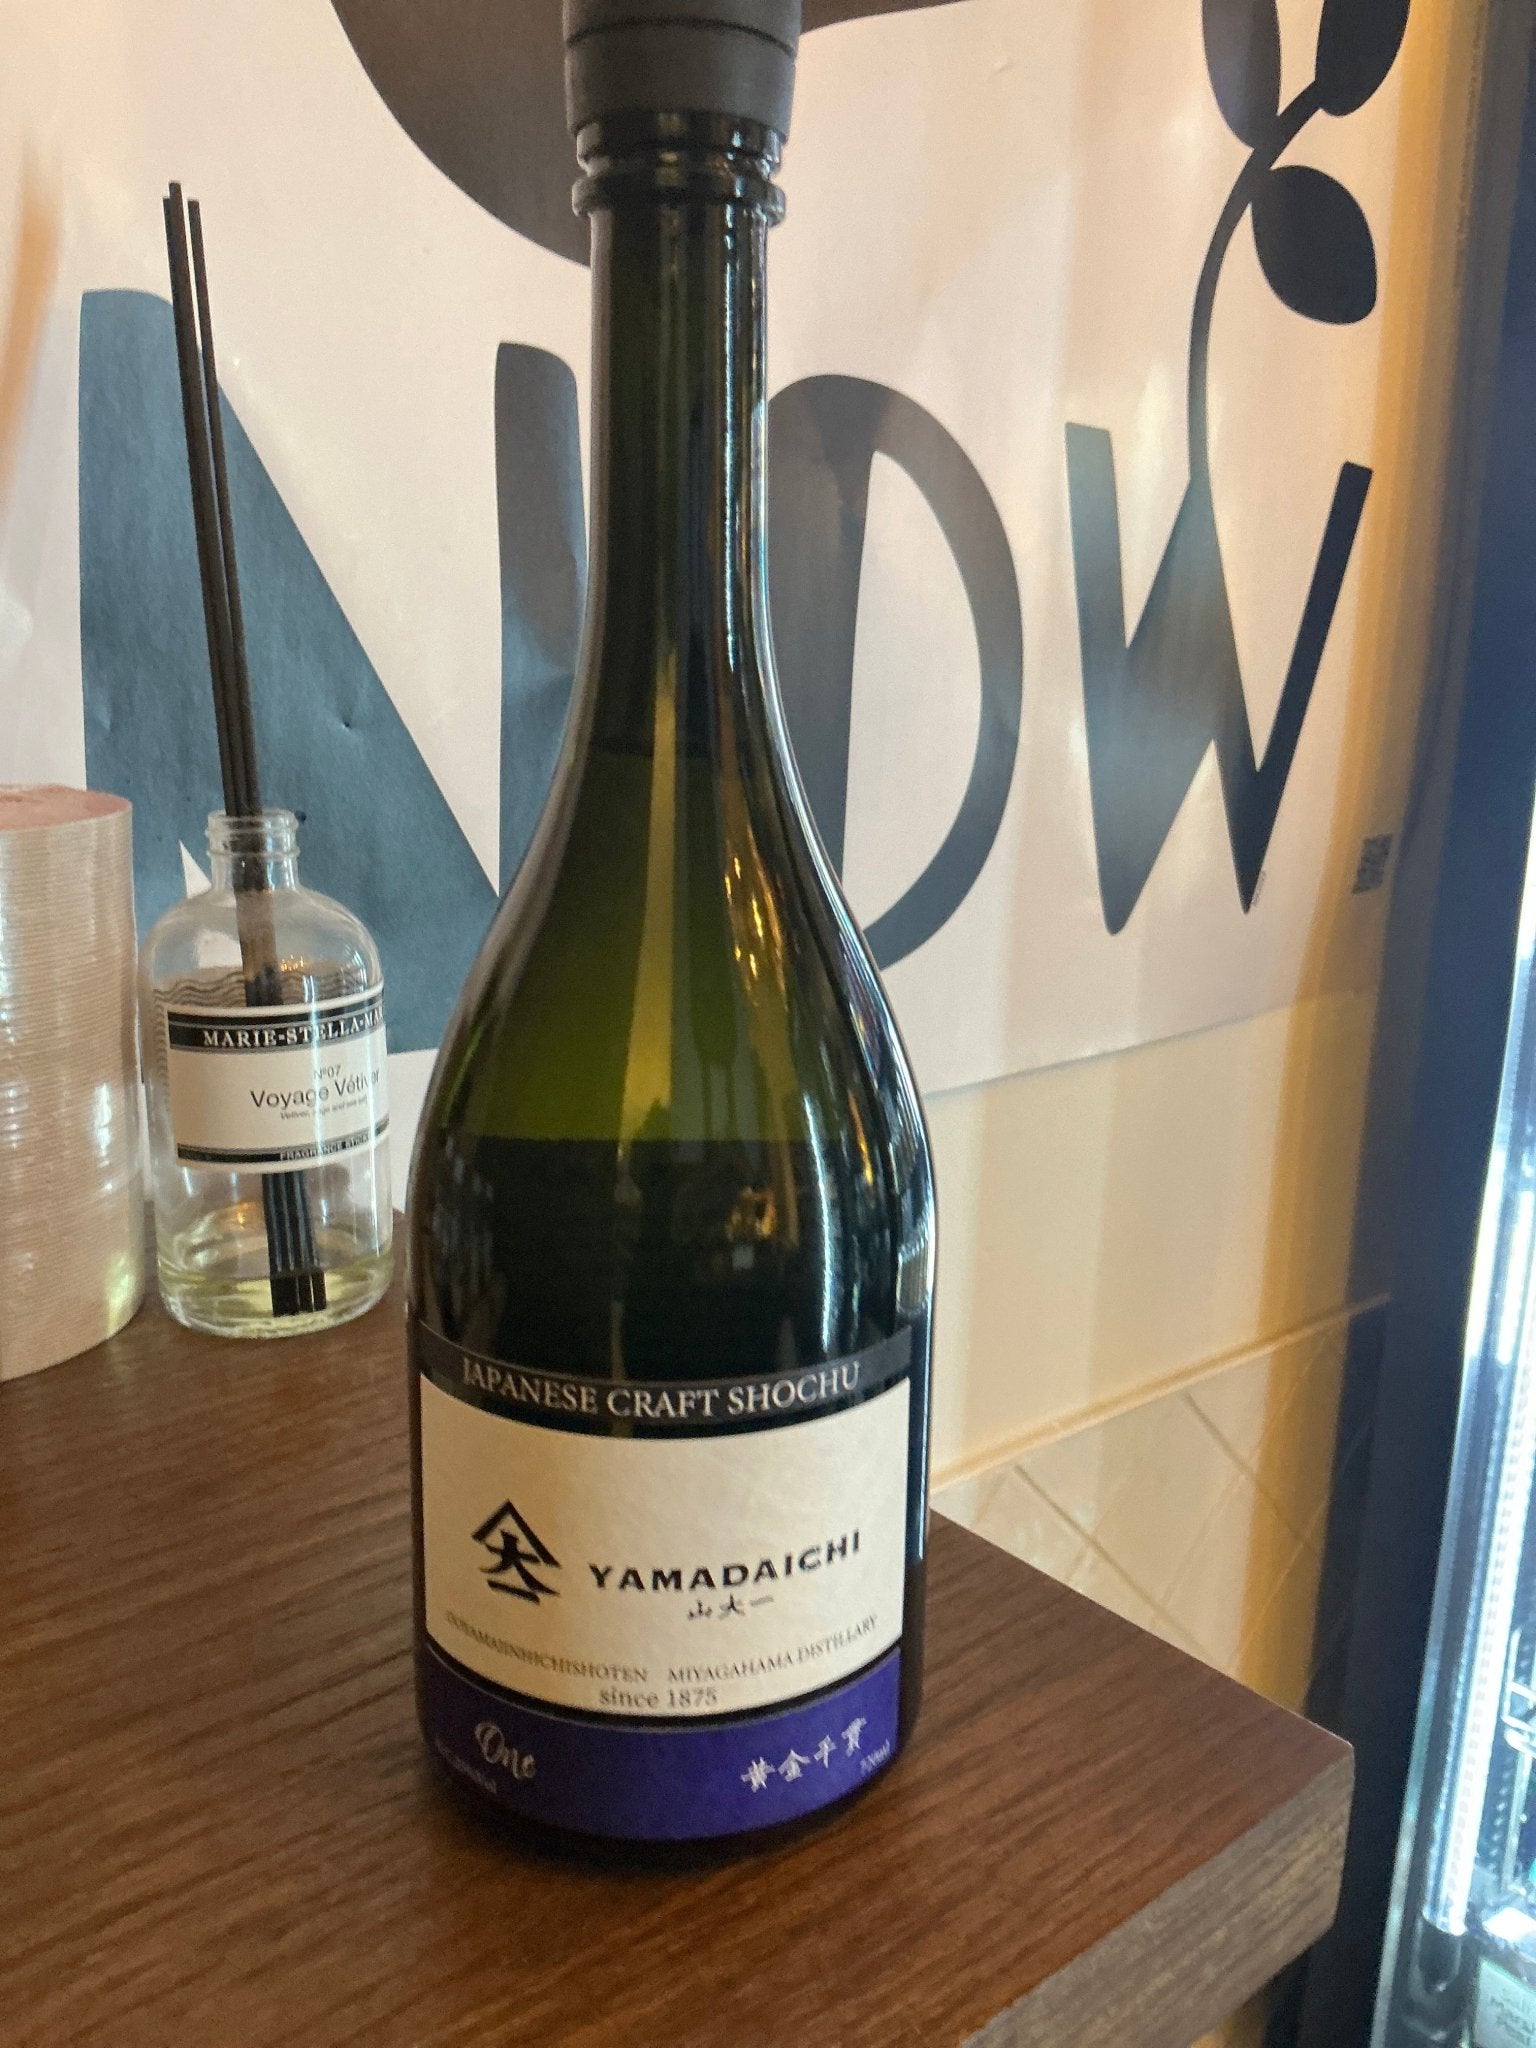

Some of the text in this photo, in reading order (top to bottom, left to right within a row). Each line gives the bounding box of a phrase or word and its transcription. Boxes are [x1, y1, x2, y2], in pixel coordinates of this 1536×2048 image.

[250, 1086, 329, 1110] Voyage
[461, 1356, 860, 1418] JAPANESE CRAFT SHOCHU
[588, 1528, 861, 1592] YAMADAICHI
[600, 1685, 718, 1709] since 1875
[474, 1722, 537, 1780] One
